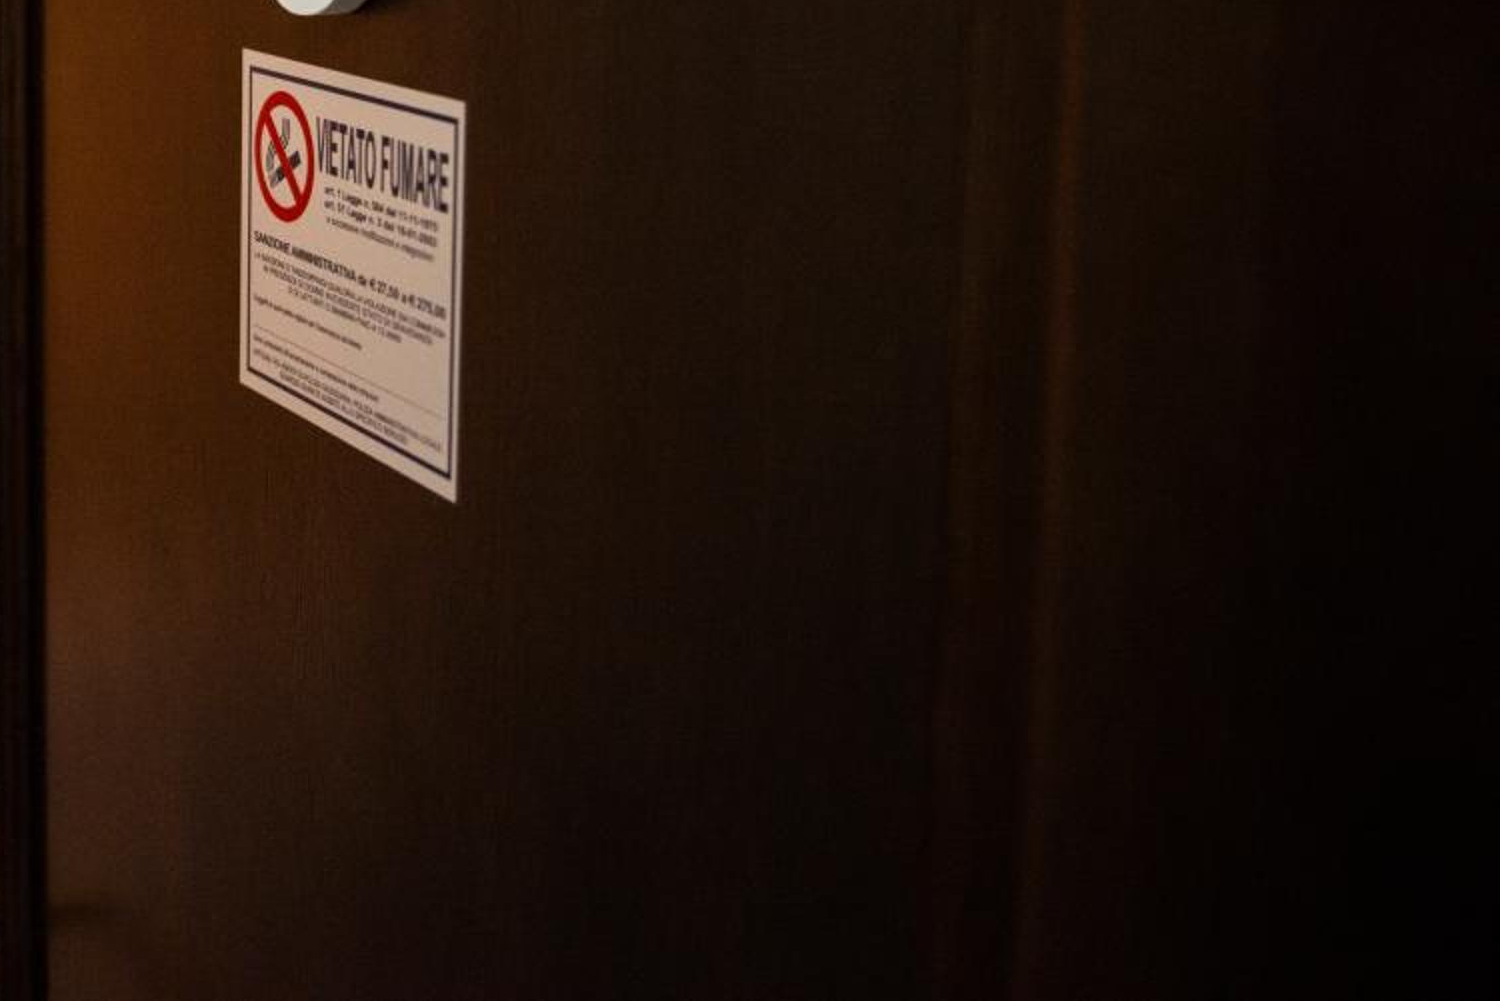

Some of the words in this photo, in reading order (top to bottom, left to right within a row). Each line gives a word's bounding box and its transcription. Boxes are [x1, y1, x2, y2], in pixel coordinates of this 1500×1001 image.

[316, 116, 377, 189] VIETATO
[381, 135, 449, 214] FUMARE
[254, 230, 291, 255] SANZIONE
